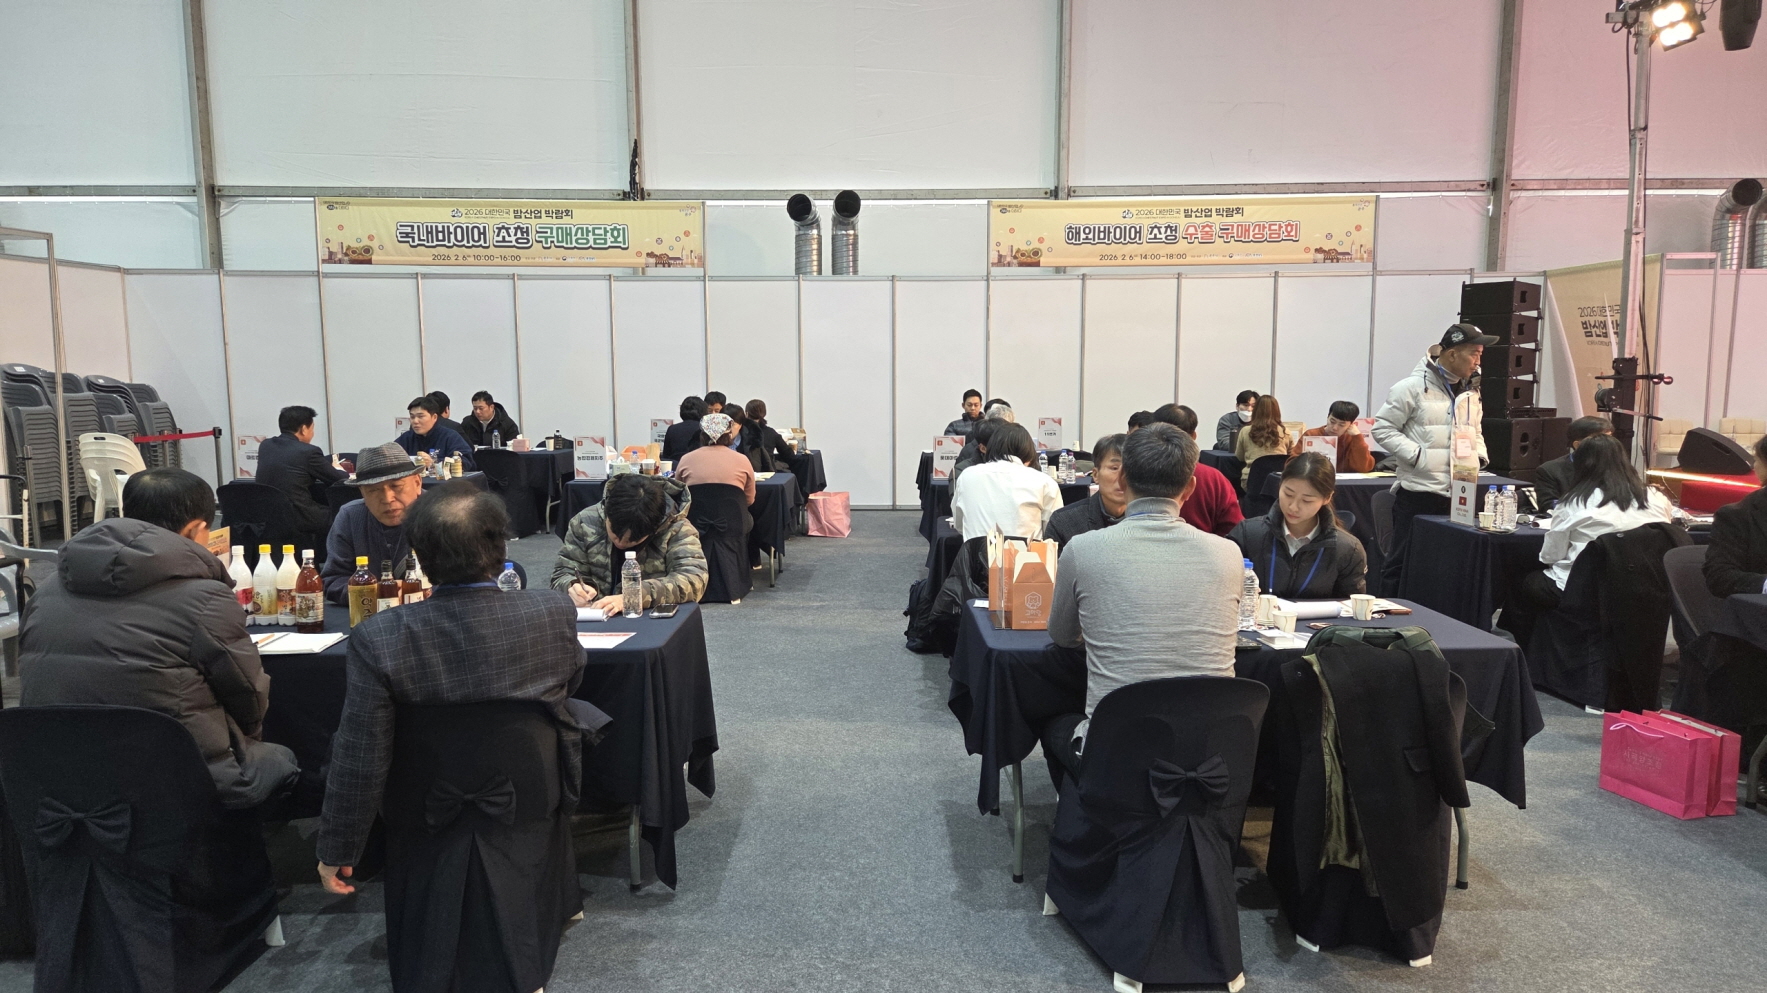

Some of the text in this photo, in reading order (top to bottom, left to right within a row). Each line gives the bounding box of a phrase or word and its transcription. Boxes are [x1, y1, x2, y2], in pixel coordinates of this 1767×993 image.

[464, 208, 573, 219] 2026 대한민국 밤산업 박람회
[1135, 206, 1244, 218] 2026 대한민국 밤산업 박람회
[397, 222, 628, 247] 국내바이어 초청 구매상담회
[1065, 221, 1300, 244] 해외바이어 초청 수출 구매상담회
